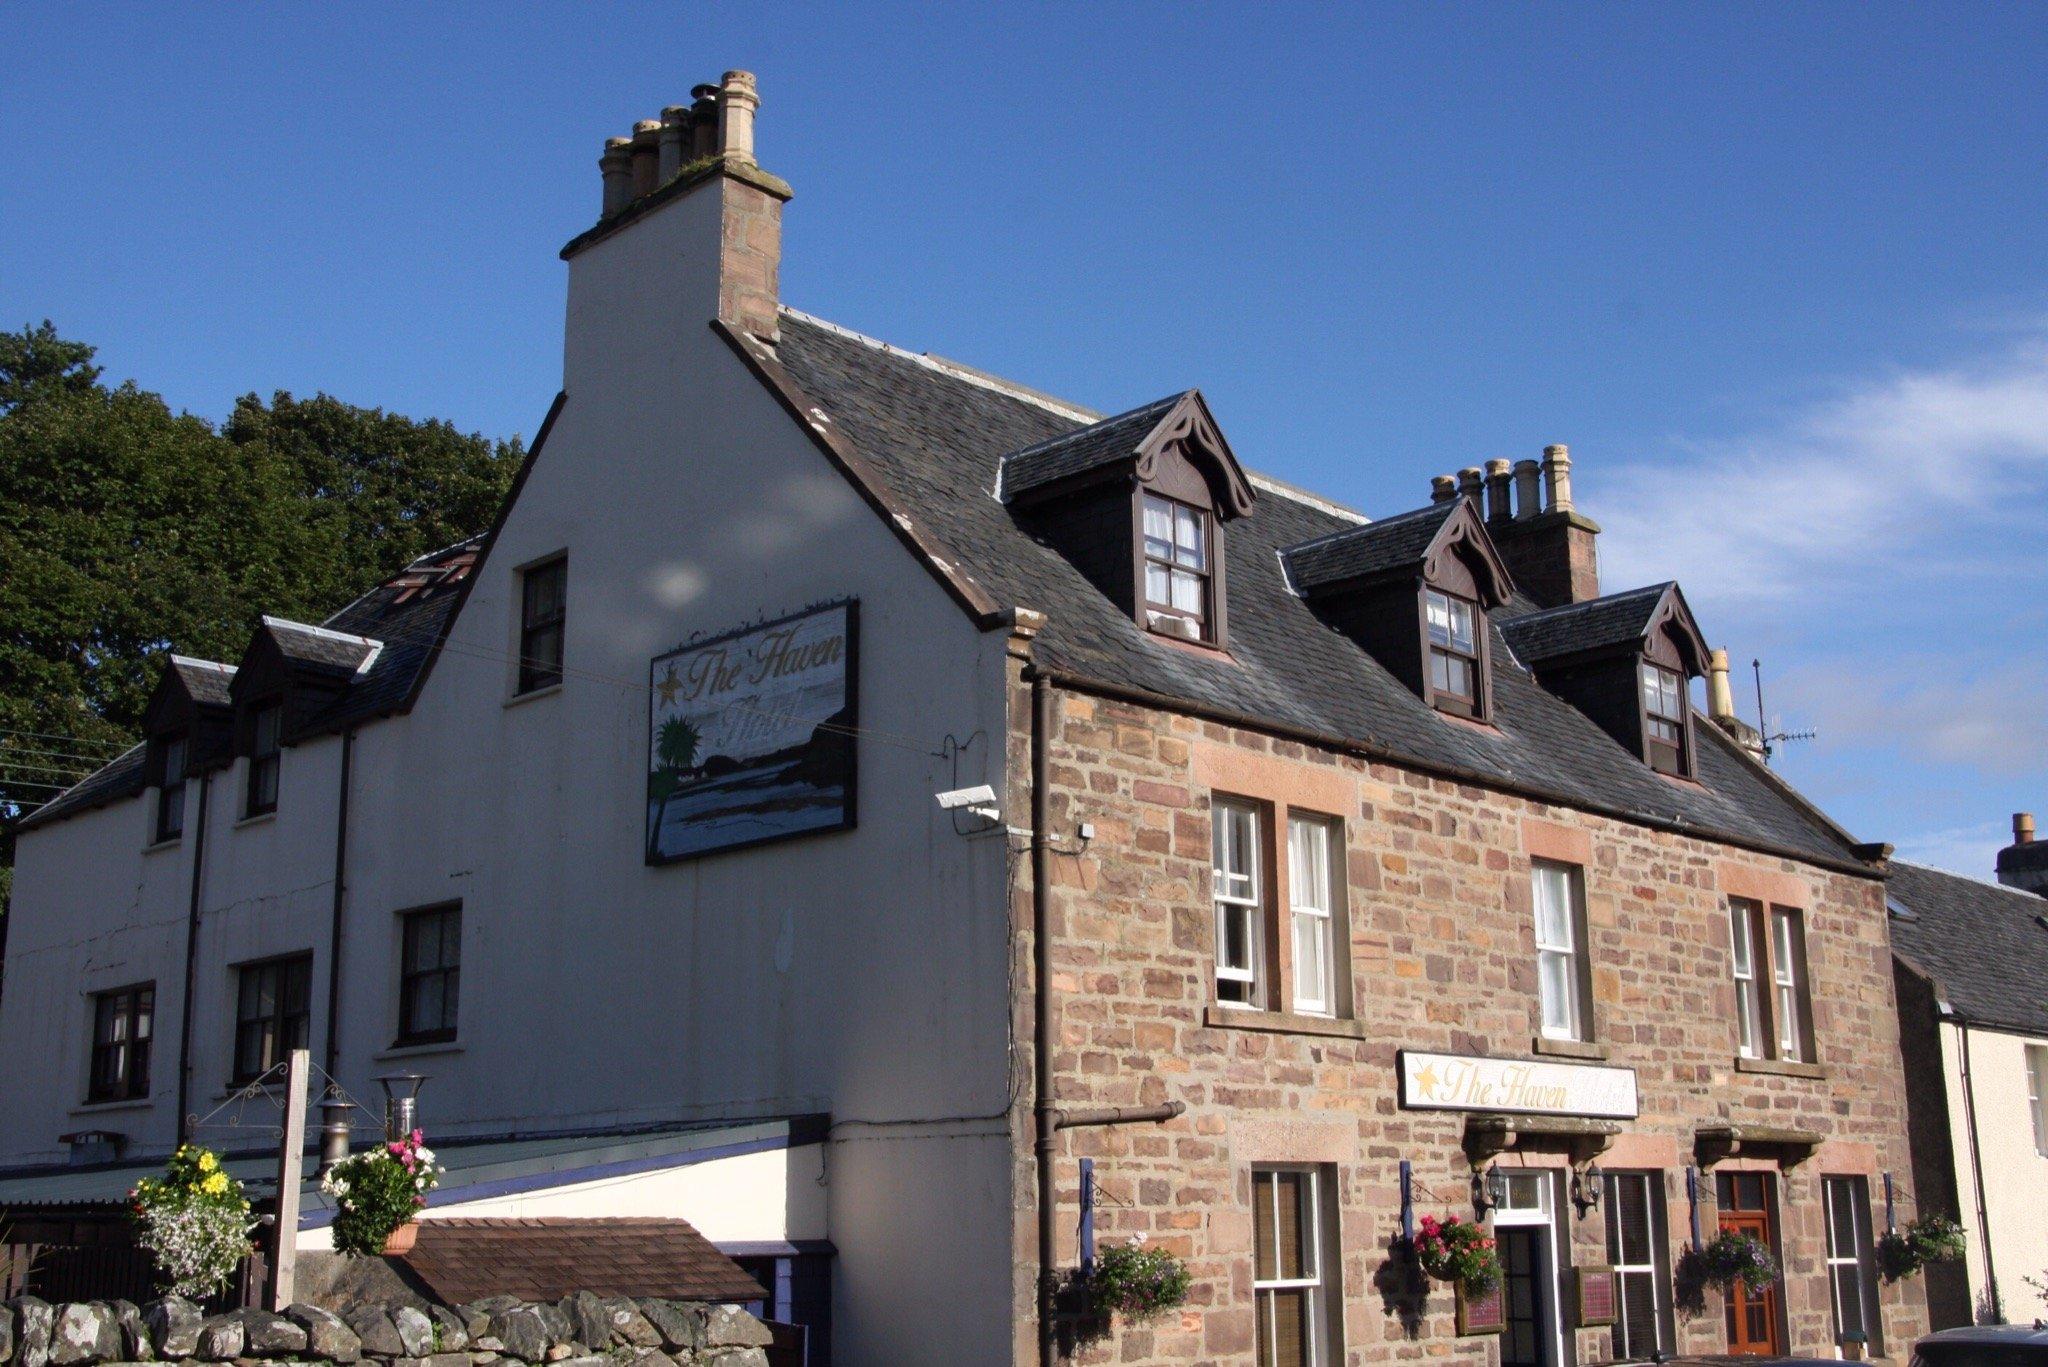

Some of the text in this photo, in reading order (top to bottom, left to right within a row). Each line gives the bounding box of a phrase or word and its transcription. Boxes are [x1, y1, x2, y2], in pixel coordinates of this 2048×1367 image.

[684, 623, 843, 701] The Haven
[1440, 1059, 1491, 1105] The
[1496, 1063, 1568, 1109] Haven
